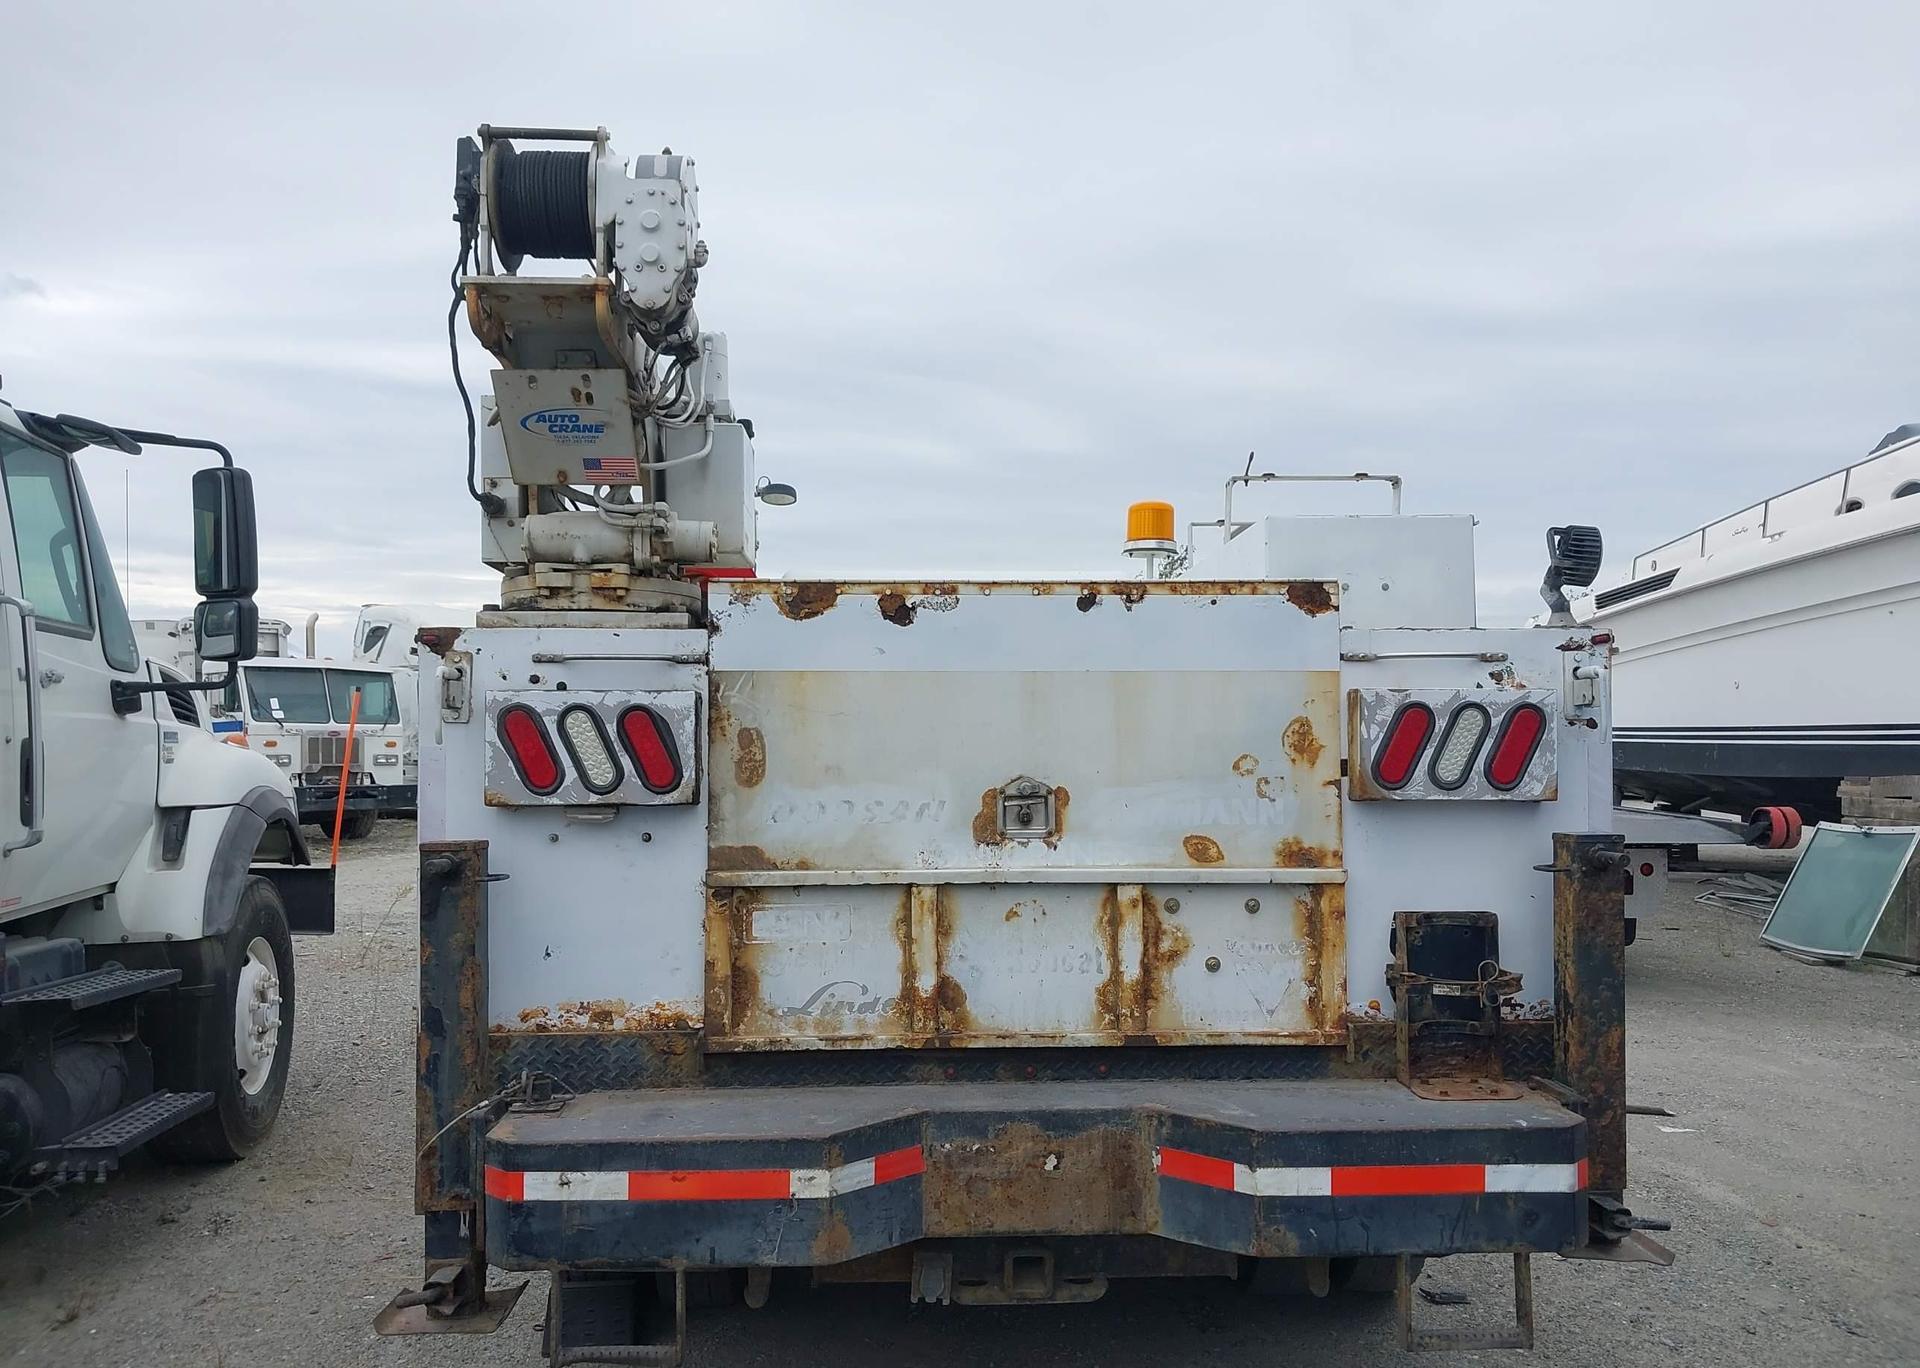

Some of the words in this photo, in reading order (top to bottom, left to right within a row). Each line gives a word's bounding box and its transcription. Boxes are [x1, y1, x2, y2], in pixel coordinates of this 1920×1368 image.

[535, 414, 580, 424] AUTO
[548, 423, 605, 434] CRANE
[781, 980, 898, 1017] Linde
